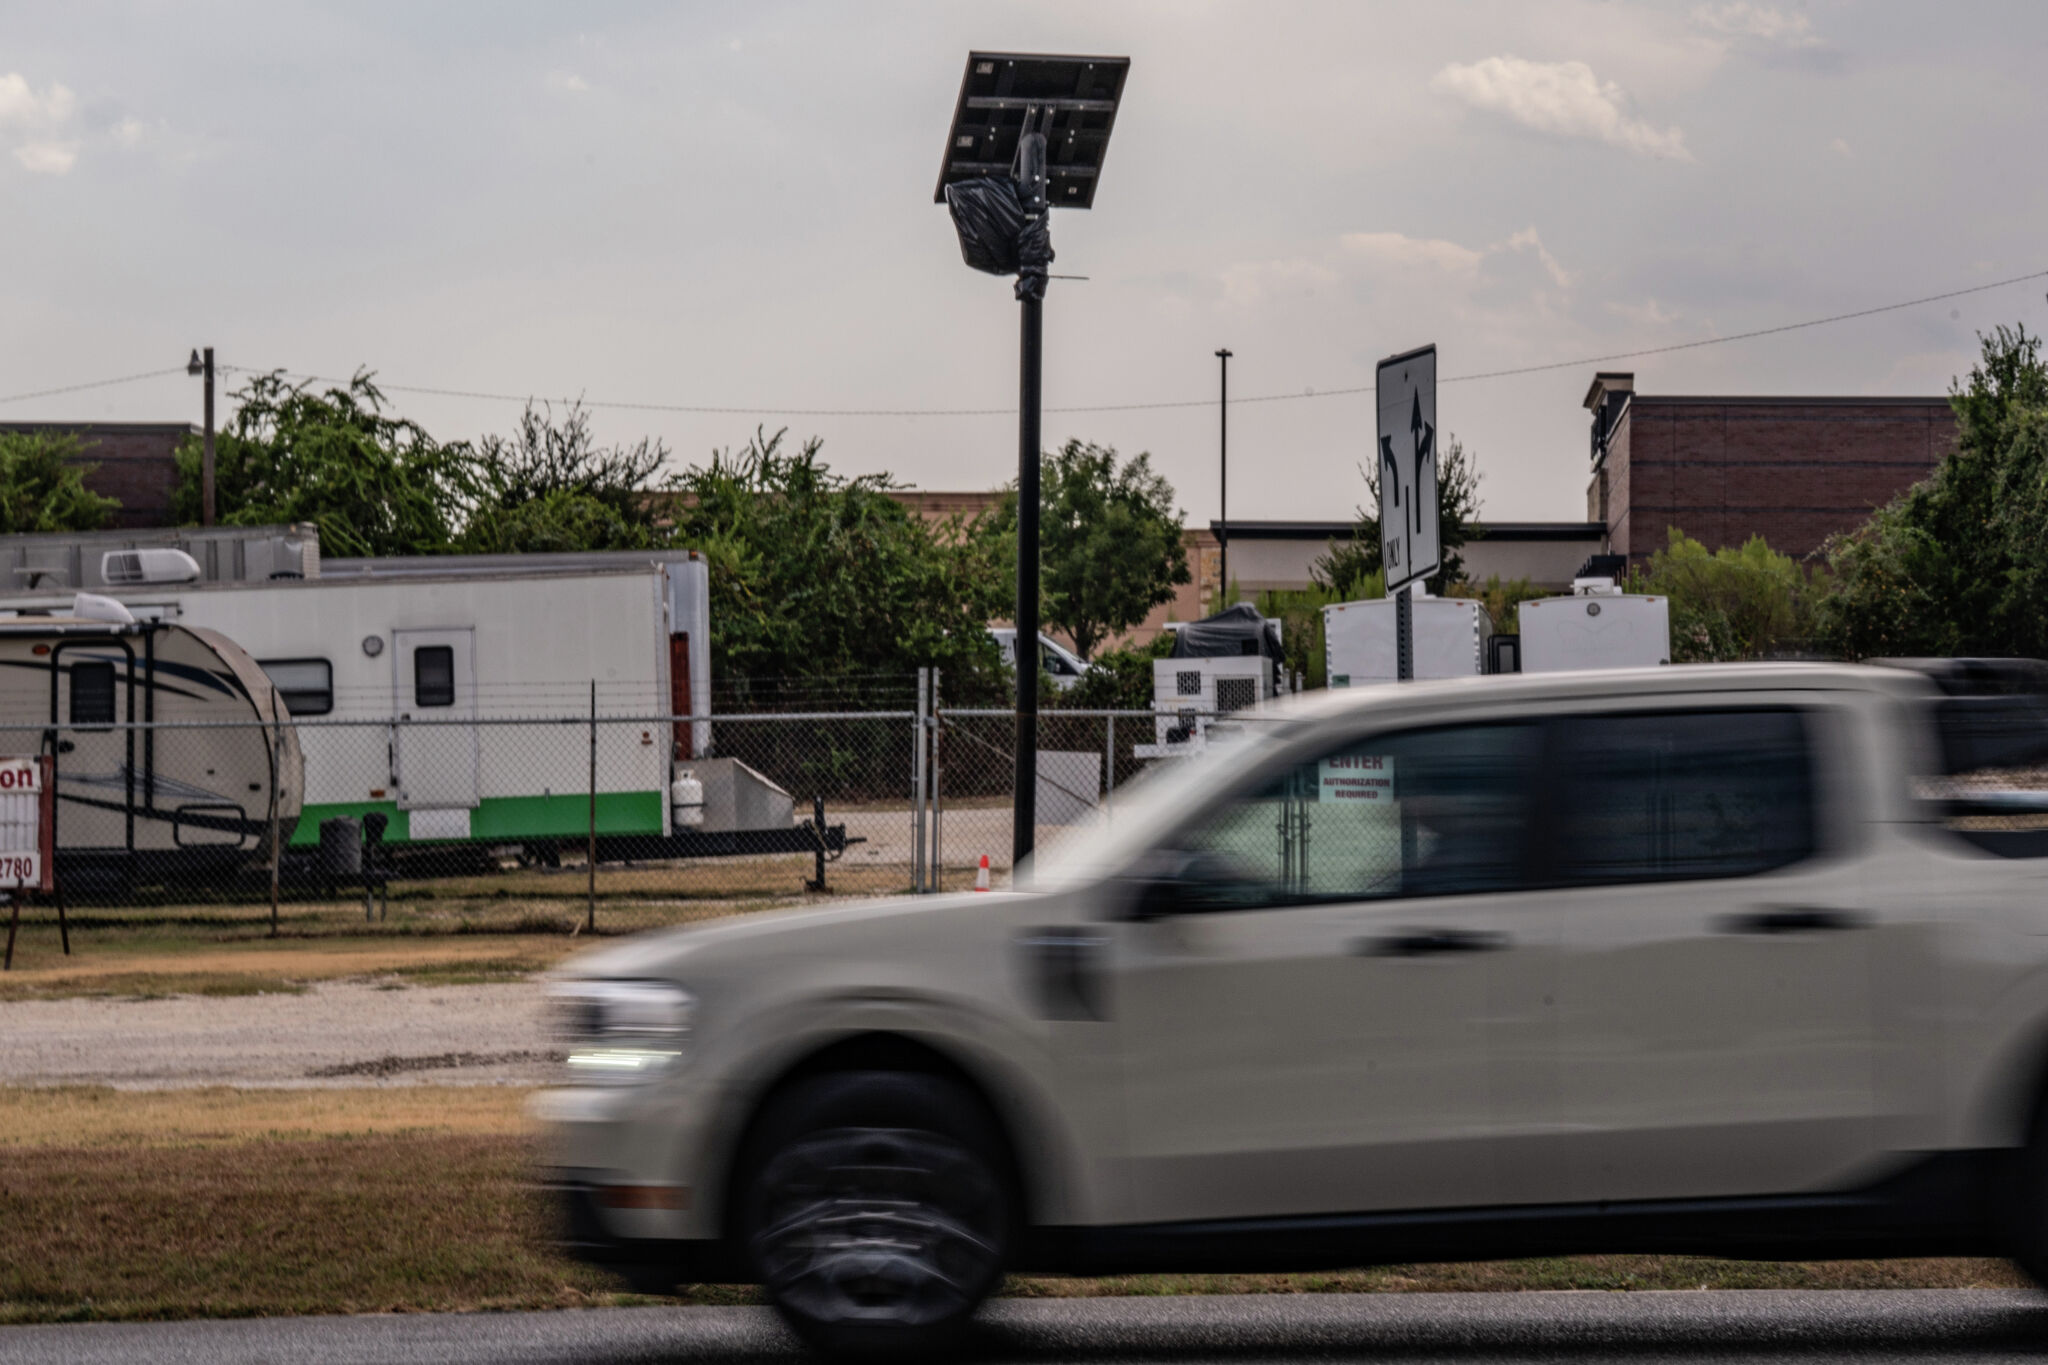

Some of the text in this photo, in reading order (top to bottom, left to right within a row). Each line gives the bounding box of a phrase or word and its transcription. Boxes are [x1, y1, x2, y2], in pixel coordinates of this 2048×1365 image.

[1386, 536, 1400, 570] ONLY
[1328, 755, 1383, 770] ENTER
[0, 768, 33, 788] on
[1323, 778, 1391, 787] AUTHORIZATION
[1335, 790, 1378, 799] REQUIRED
